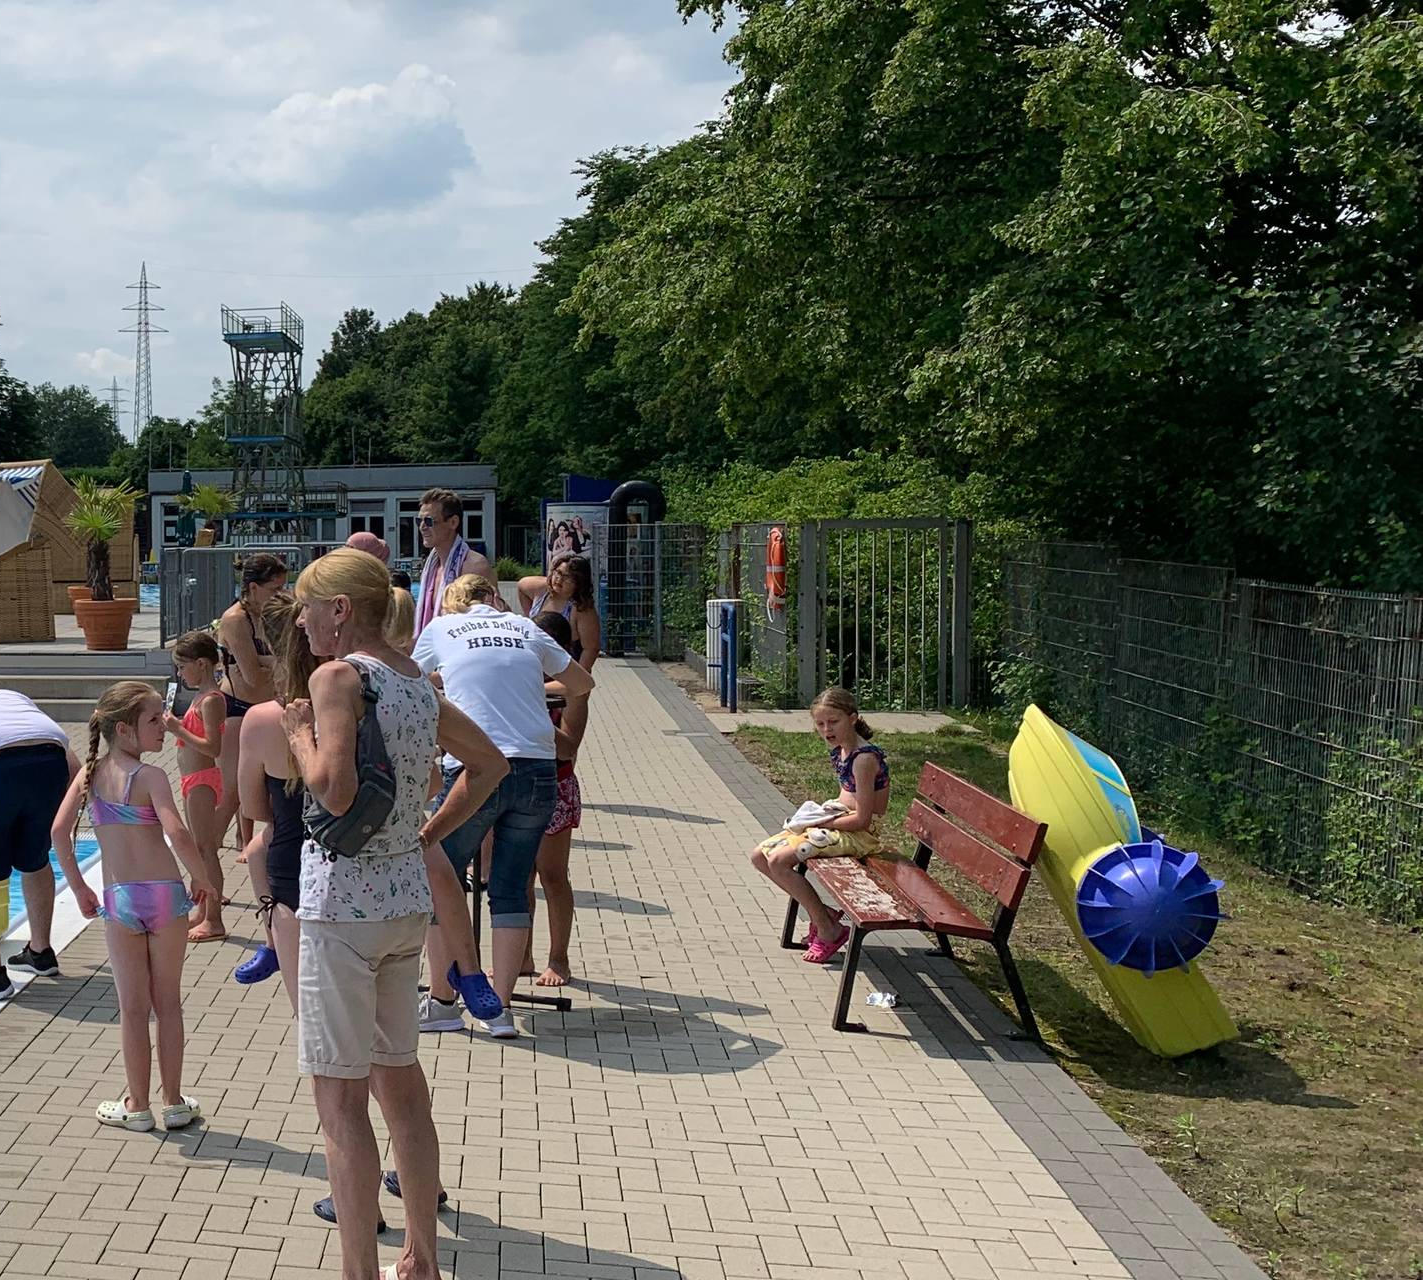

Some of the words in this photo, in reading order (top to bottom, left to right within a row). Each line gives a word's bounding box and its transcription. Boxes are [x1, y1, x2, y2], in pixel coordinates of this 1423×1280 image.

[447, 621, 489, 638] Freibad
[492, 621, 530, 639] Dellwig
[466, 636, 525, 650] HESSE
